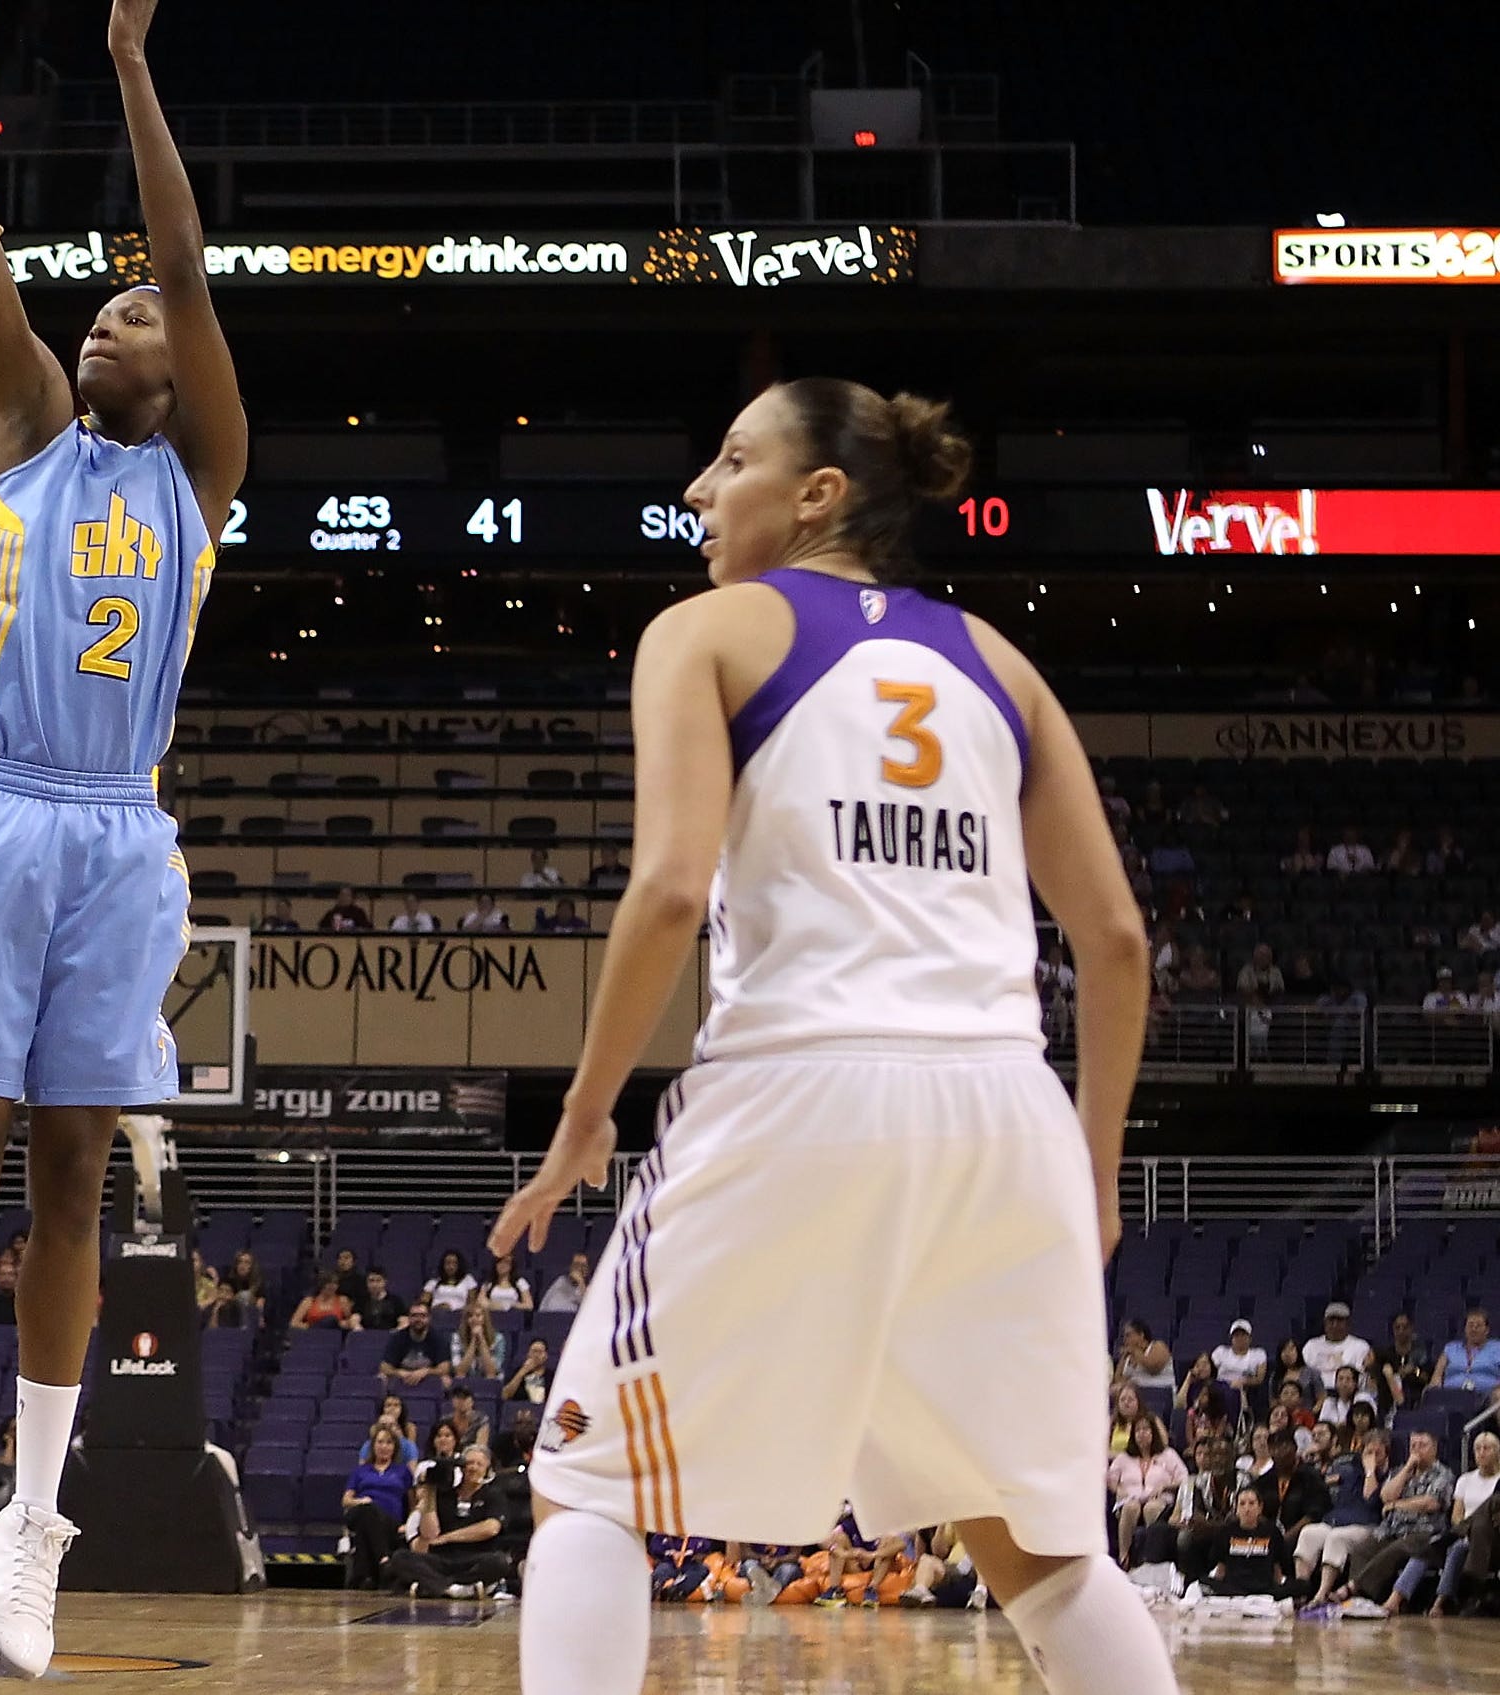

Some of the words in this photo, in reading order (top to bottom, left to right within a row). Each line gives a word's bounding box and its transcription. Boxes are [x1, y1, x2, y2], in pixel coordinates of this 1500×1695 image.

[0, 231, 108, 283] rve!
[708, 225, 878, 287] Verve!
[1284, 243, 1431, 268] SPORTS
[1437, 231, 1500, 278] 62
[316, 495, 392, 529] 4:53
[465, 497, 522, 544] 41
[640, 504, 705, 547] Sky
[957, 497, 1010, 537] 10
[1145, 487, 1318, 556] Verve!
[310, 529, 381, 551] Quarter
[385, 529, 401, 551] 2
[76, 595, 140, 683] 2
[872, 677, 943, 789] 3
[1261, 721, 1466, 751] ANNEXUS
[828, 799, 989, 877] TAURASI
[345, 939, 548, 1002] ARIZONA
[346, 1089, 441, 1112] zone
